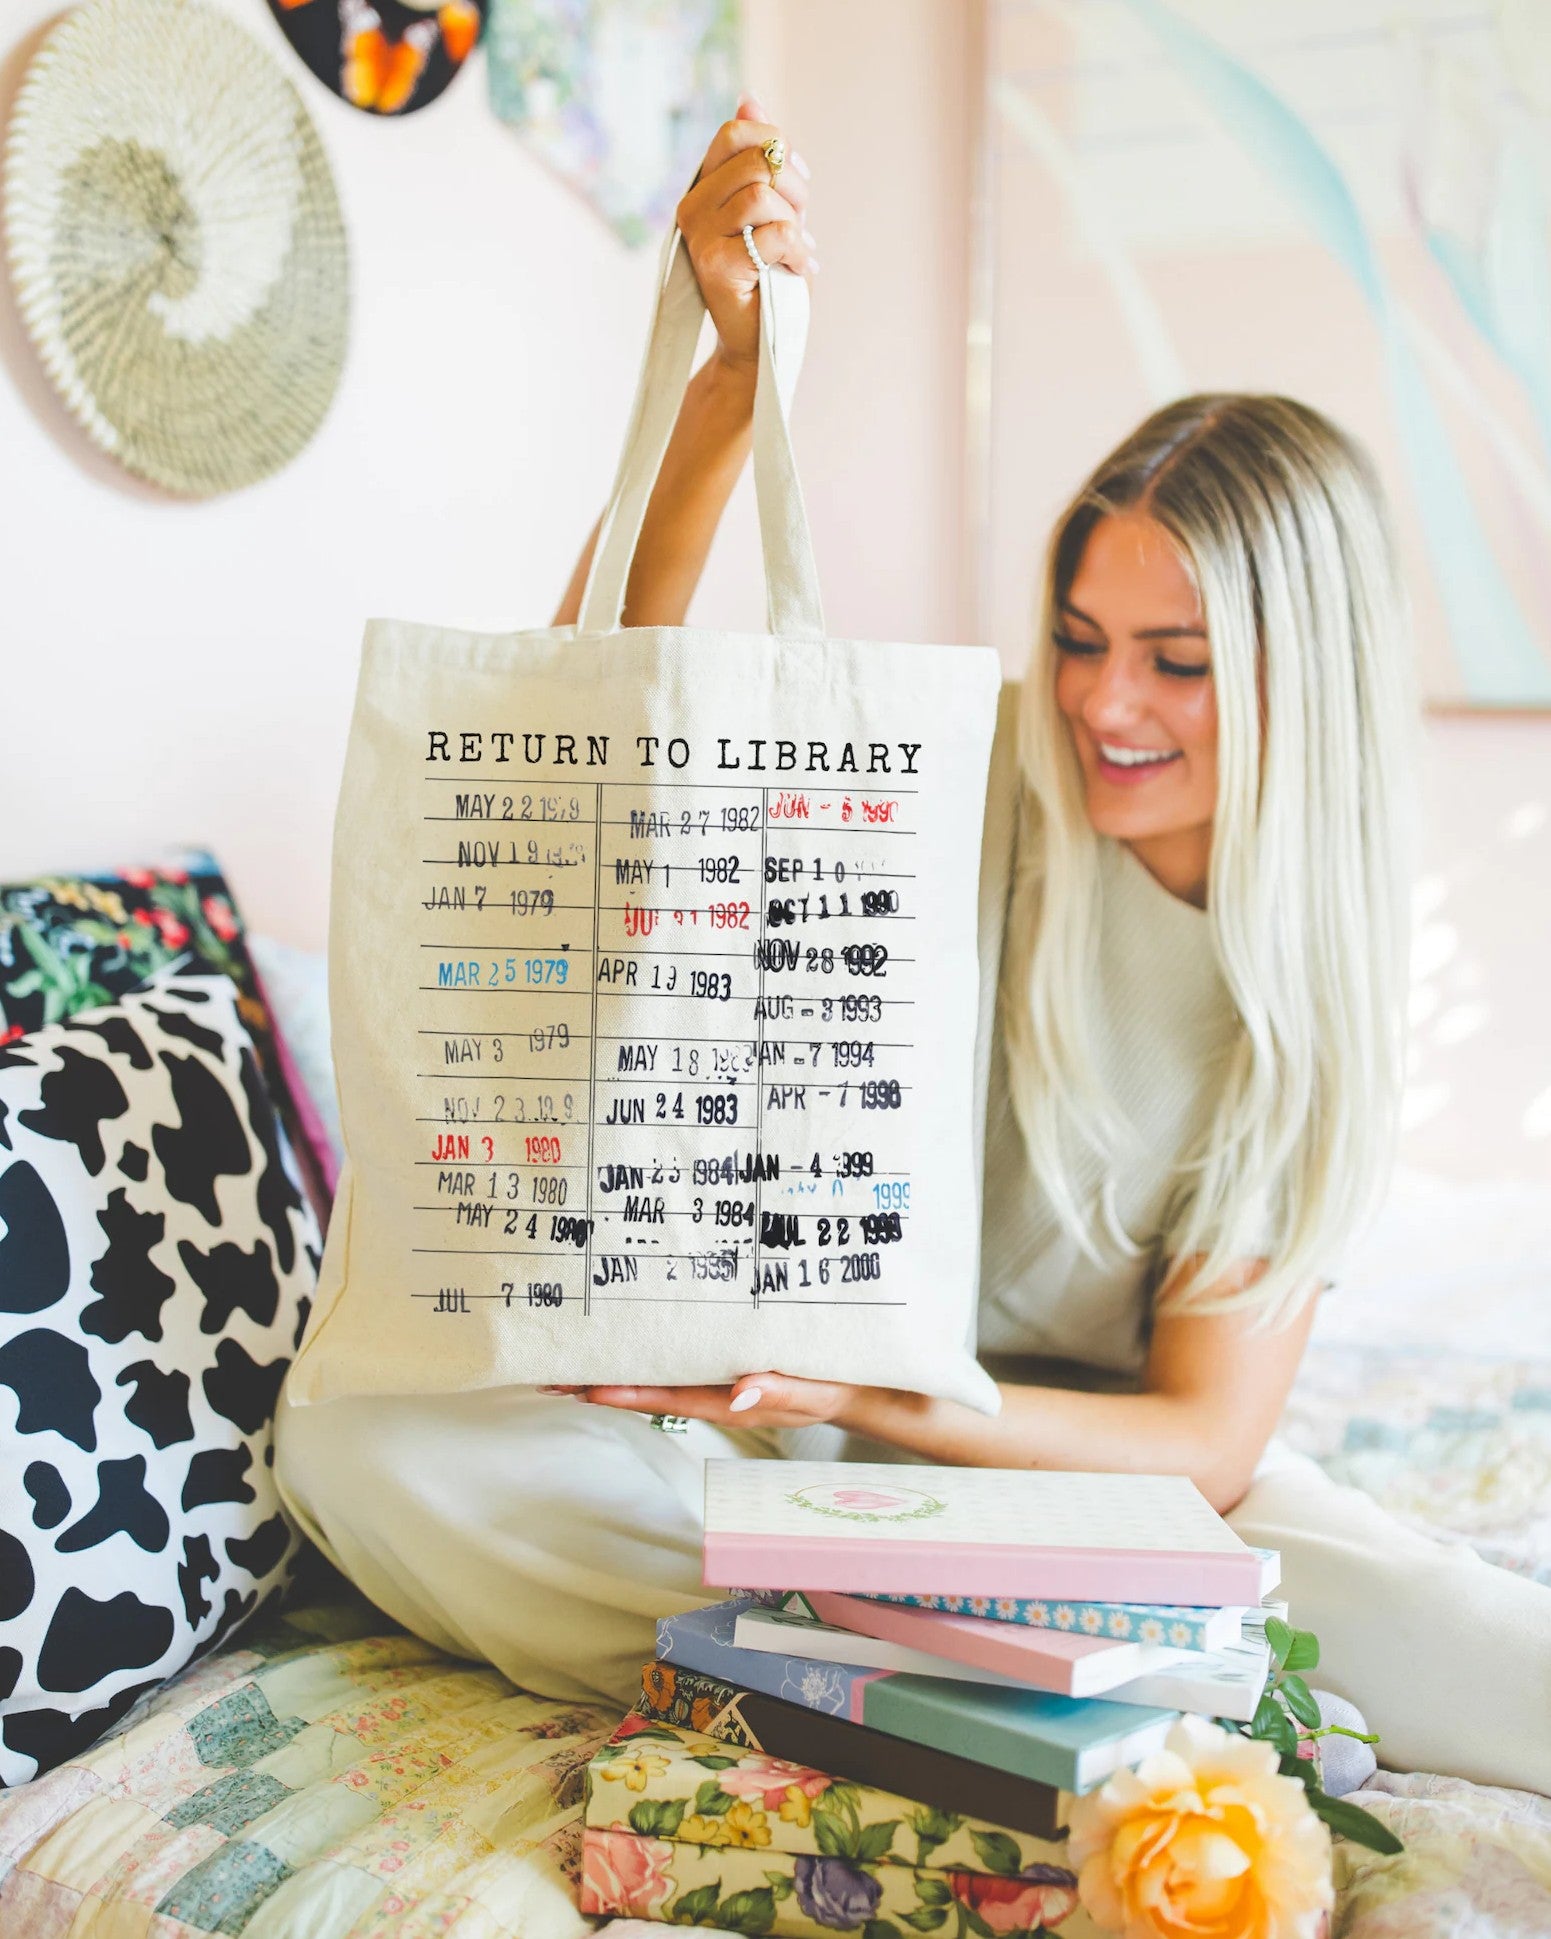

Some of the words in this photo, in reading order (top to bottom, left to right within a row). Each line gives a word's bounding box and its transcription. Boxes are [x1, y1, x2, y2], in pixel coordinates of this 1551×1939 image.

[426, 732, 609, 765] RETURN
[636, 737, 690, 768] TO
[717, 739, 922, 773] LIBRARY
[456, 794, 495, 818] MAY
[768, 793, 810, 818] JUN
[630, 810, 670, 838] MAR
[721, 806, 759, 832] 1982
[458, 841, 499, 867] NOV
[616, 859, 654, 884] MAY
[663, 864, 669, 888] 1
[699, 856, 740, 884] 1982
[764, 856, 803, 882] SEP
[424, 886, 465, 911] JAN
[475, 886, 487, 911] 7
[510, 889, 554, 916] 1979
[709, 902, 750, 930] 1982
[754, 939, 800, 972] NOV
[438, 962, 480, 986] MAR
[525, 959, 569, 985] 1979
[598, 958, 638, 986] APR
[691, 971, 731, 1001] 1983
[754, 995, 793, 1020] AUG
[822, 998, 833, 1022] 3
[839, 995, 881, 1022] 1993
[445, 1038, 481, 1064] MAY
[493, 1038, 503, 1062] 3
[529, 1023, 570, 1052] 1979
[810, 1043, 822, 1067] 7
[832, 1041, 874, 1067] 1994
[618, 1045, 658, 1072] MAY
[606, 1099, 644, 1124] JUN
[696, 1093, 738, 1125] 1983
[767, 1085, 805, 1110] APR
[432, 1134, 469, 1160] JAN
[481, 1136, 493, 1162] 3
[525, 1136, 561, 1163] 1980
[599, 1164, 643, 1193] JAN
[739, 1153, 779, 1182] JAN
[810, 1152, 822, 1177] 4
[438, 1171, 475, 1195] MAR
[533, 1176, 567, 1205] 1980
[457, 1202, 493, 1227] MAY
[624, 1196, 664, 1223] MAR
[692, 1198, 703, 1223] 3
[715, 1200, 754, 1226] 1984
[594, 1256, 637, 1286] JAN
[750, 1262, 788, 1295] JAN
[841, 1252, 880, 1283] 2000
[434, 1288, 470, 1312] JUL
[501, 1283, 513, 1307] 7
[528, 1283, 562, 1307] 1980
